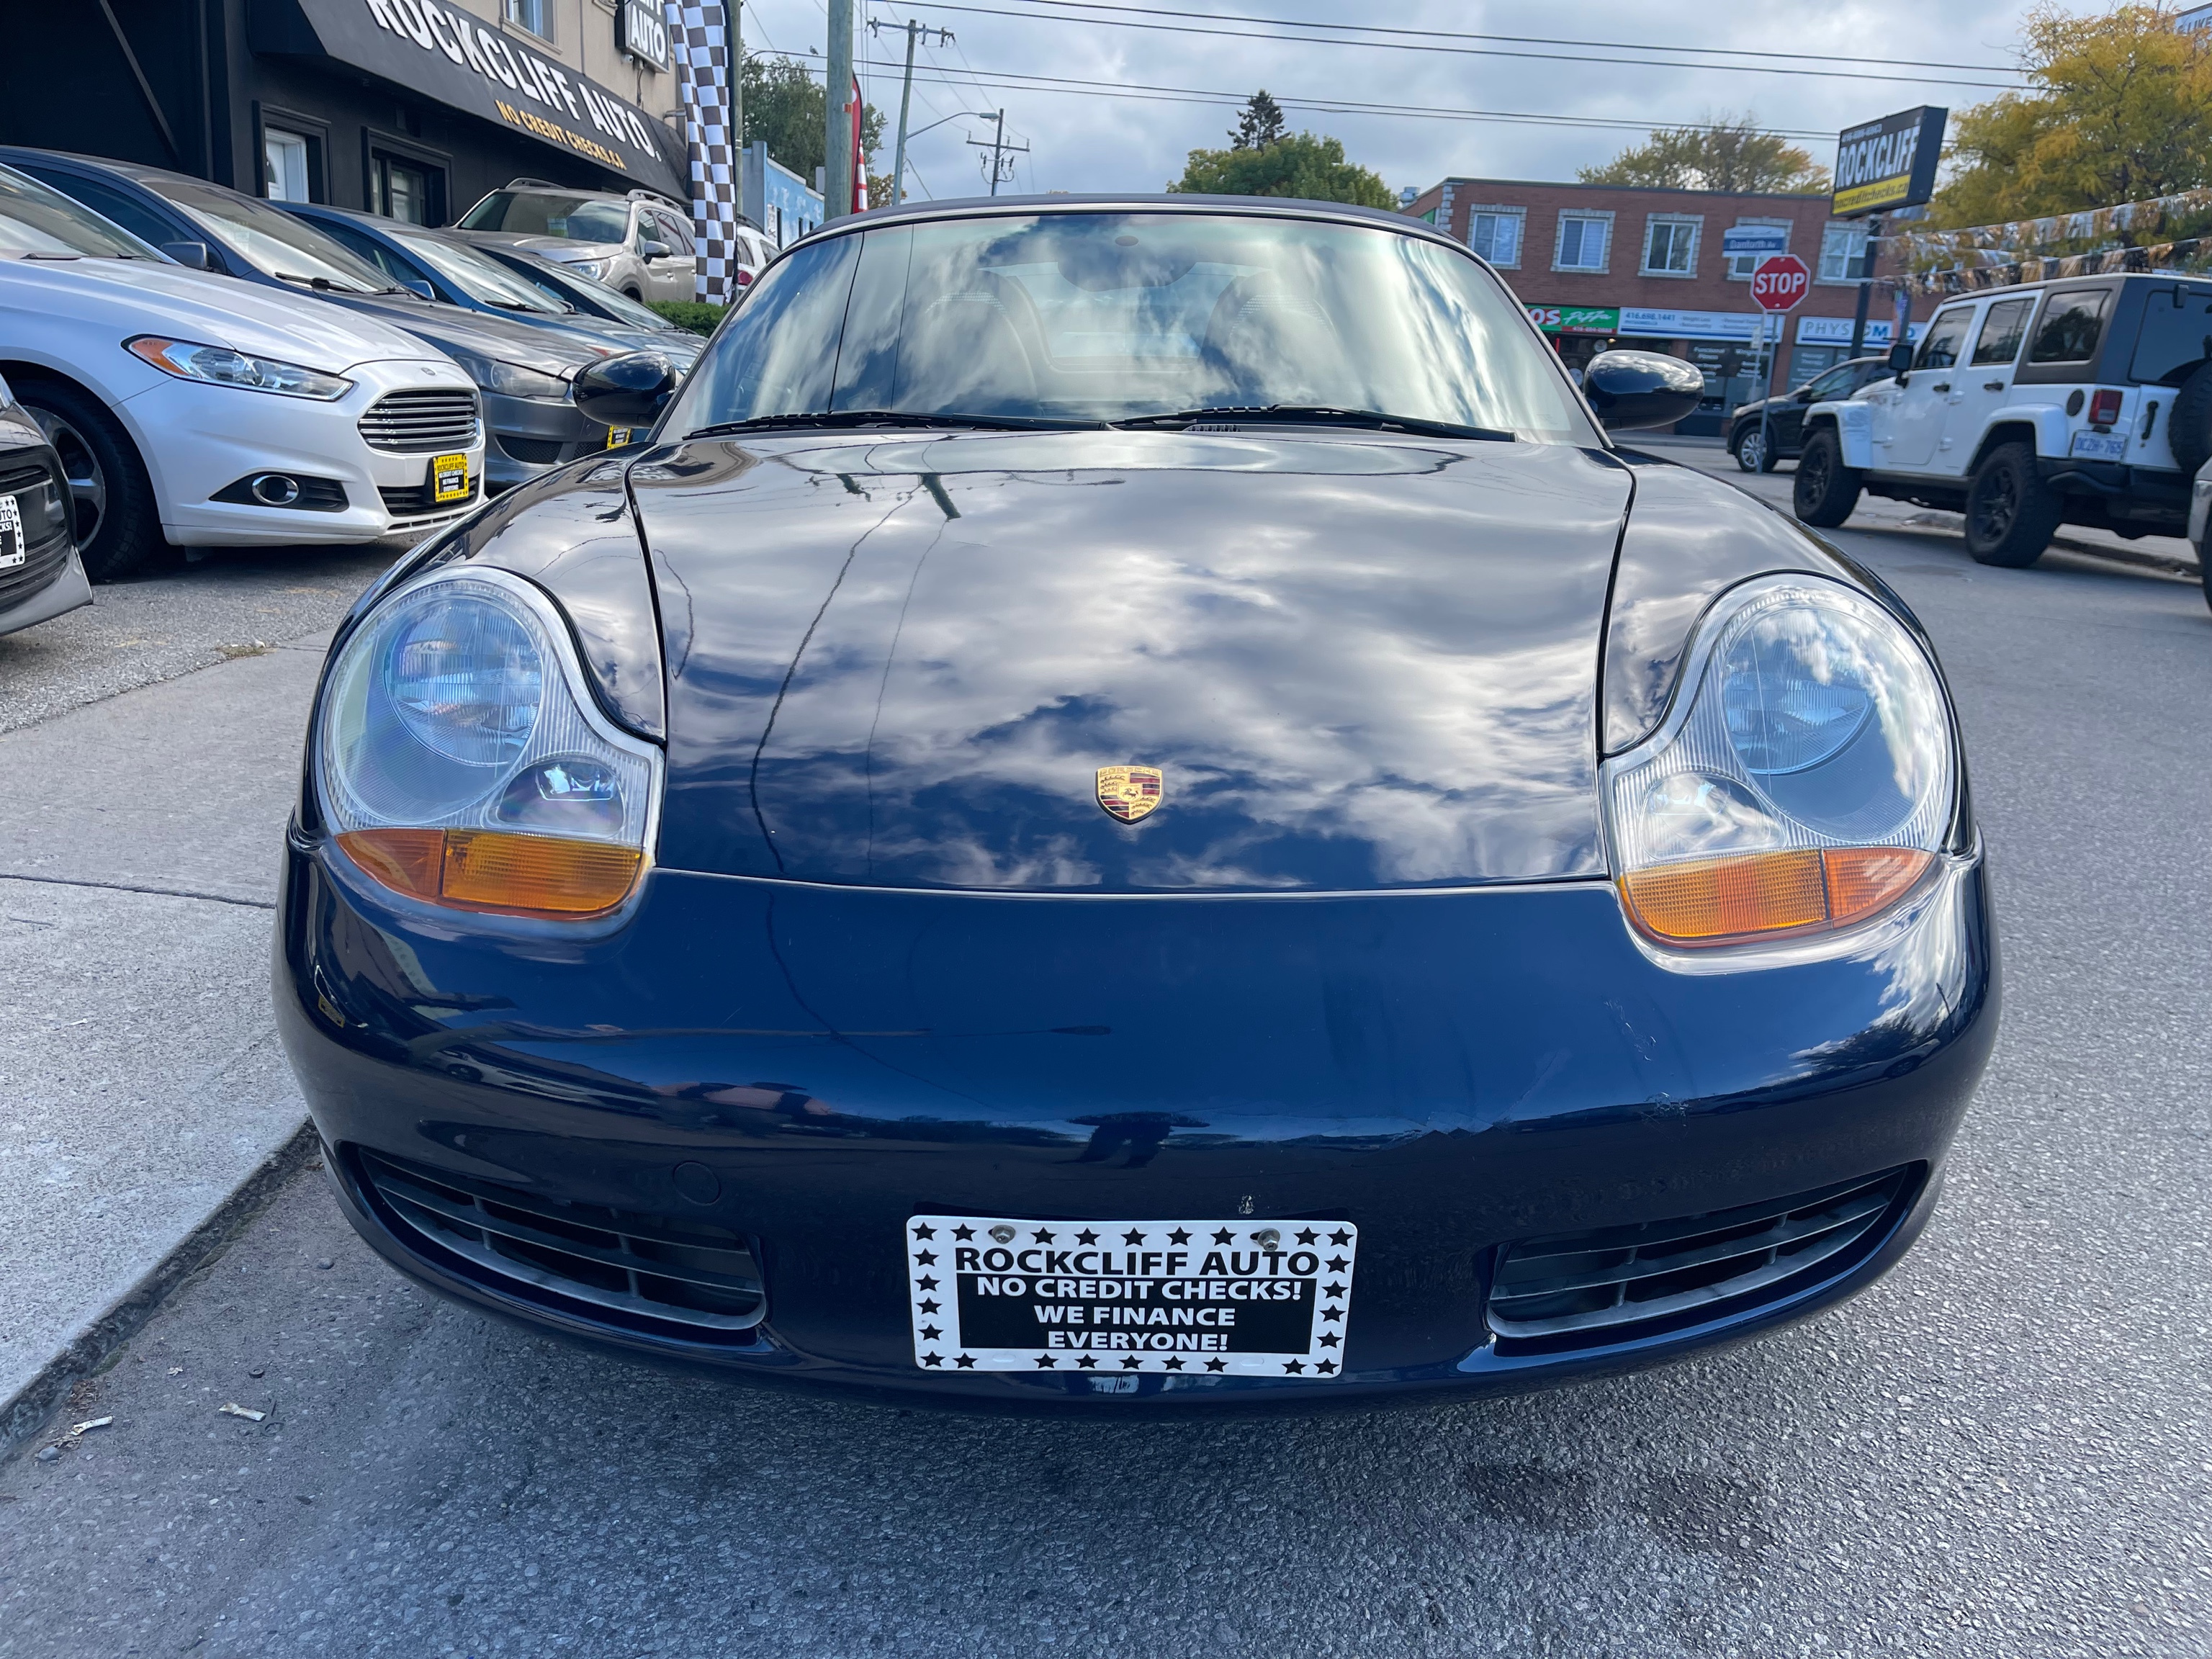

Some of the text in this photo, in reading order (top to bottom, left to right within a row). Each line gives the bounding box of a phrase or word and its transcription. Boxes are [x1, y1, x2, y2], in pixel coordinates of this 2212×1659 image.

[631, 4, 666, 63] AUTO
[495, 99, 627, 171] NO CREDIT CHECKS.CA
[1836, 125, 1920, 189] ROCKCLIFF
[1755, 272, 1805, 294] STOP
[1527, 308, 1560, 325] OS
[0, 509, 12, 521] TO
[0, 521, 12, 532] KS!
[955, 1247, 1319, 1276] ROCKCLIFF AUTO
[977, 1277, 1302, 1300] NO CREDIT CHECKS!
[1033, 1305, 1235, 1326] WE FINANCE
[1048, 1331, 1228, 1351] EVERYONE!
